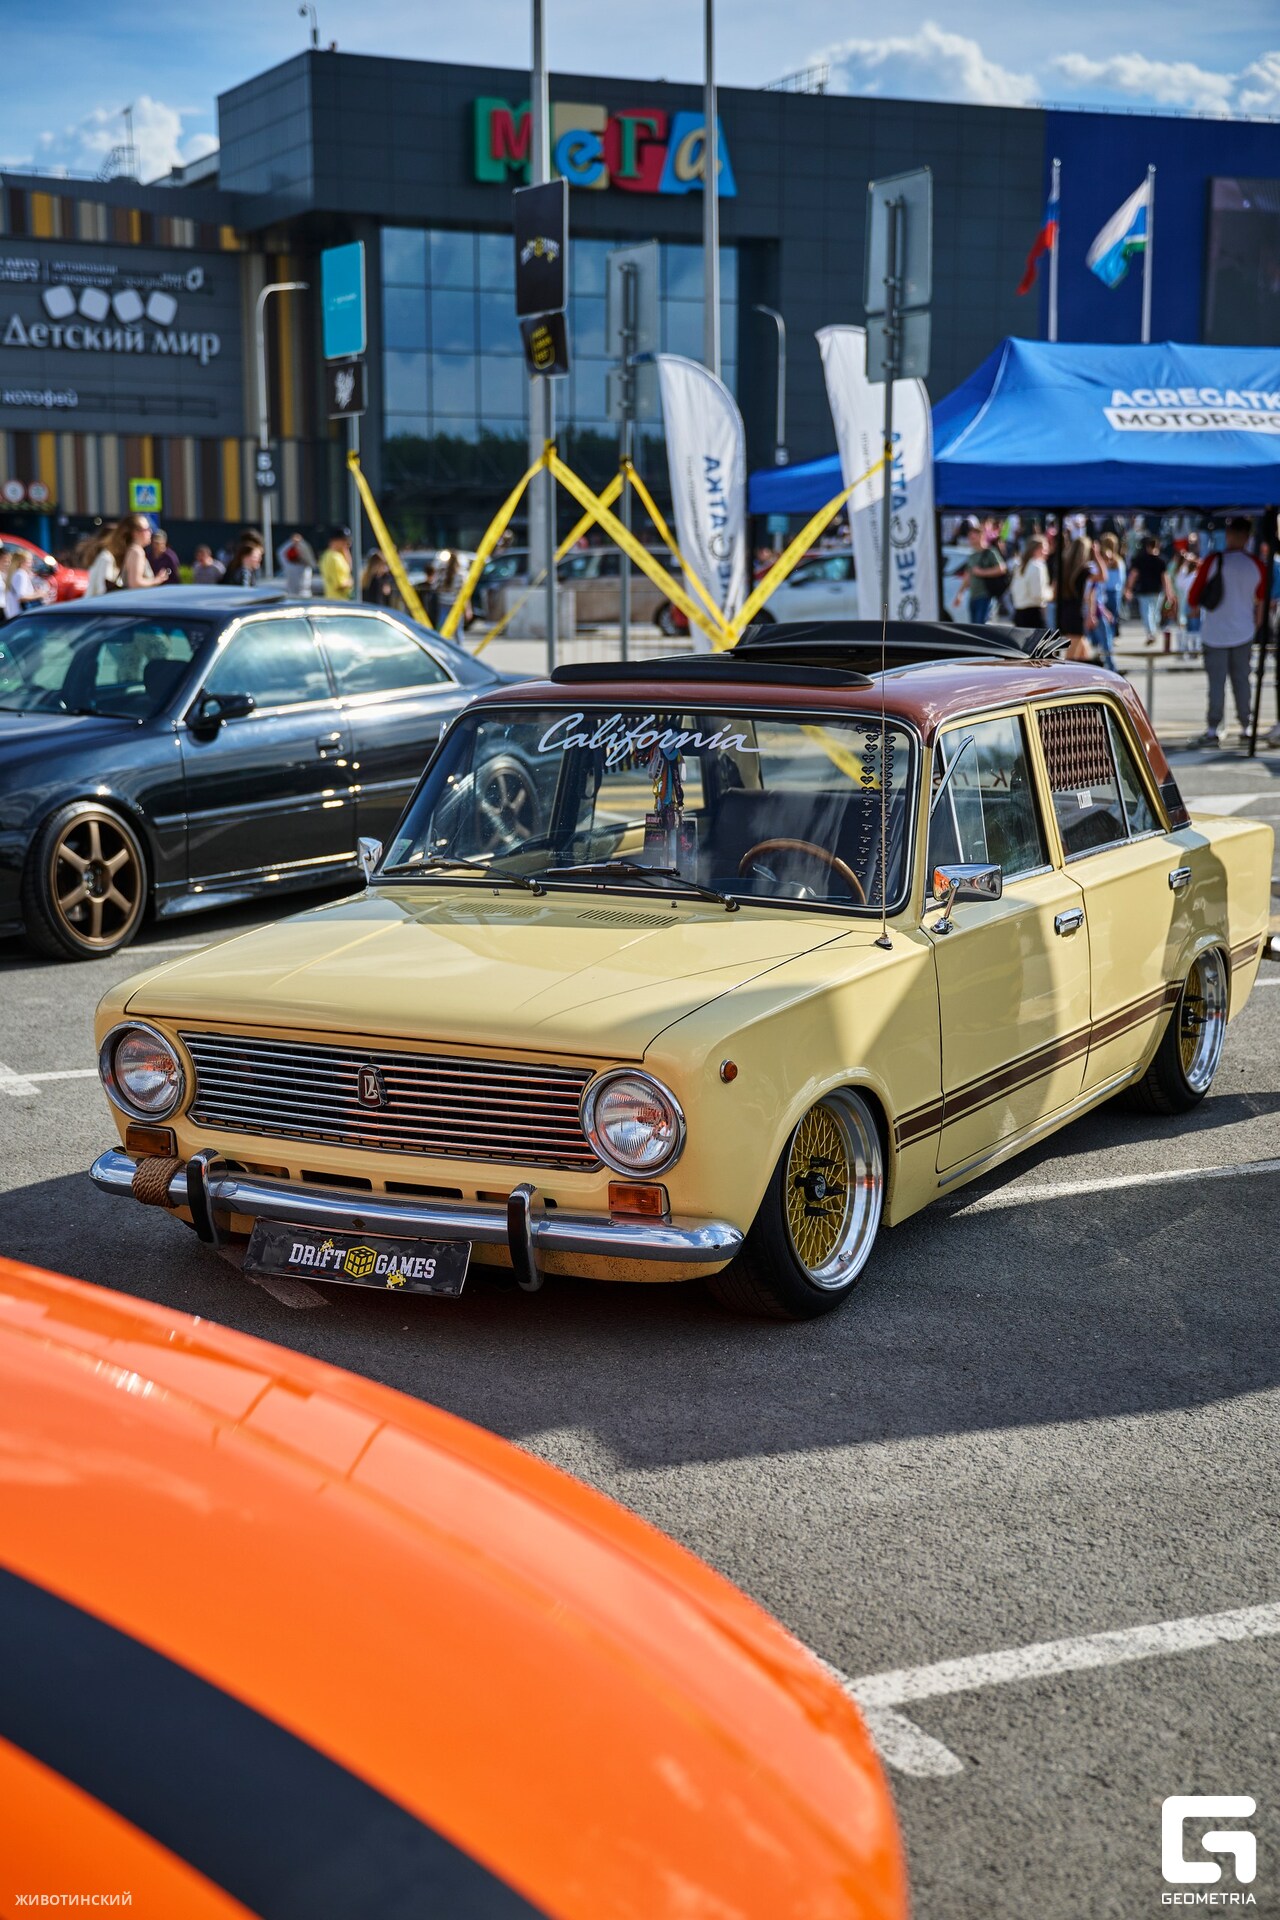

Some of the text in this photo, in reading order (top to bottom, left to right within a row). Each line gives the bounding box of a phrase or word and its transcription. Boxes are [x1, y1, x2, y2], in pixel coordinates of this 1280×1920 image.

[3, 313, 221, 365] Детский мир
[537, 712, 769, 767] California
[288, 1243, 437, 1279] DRIFT GAMES
